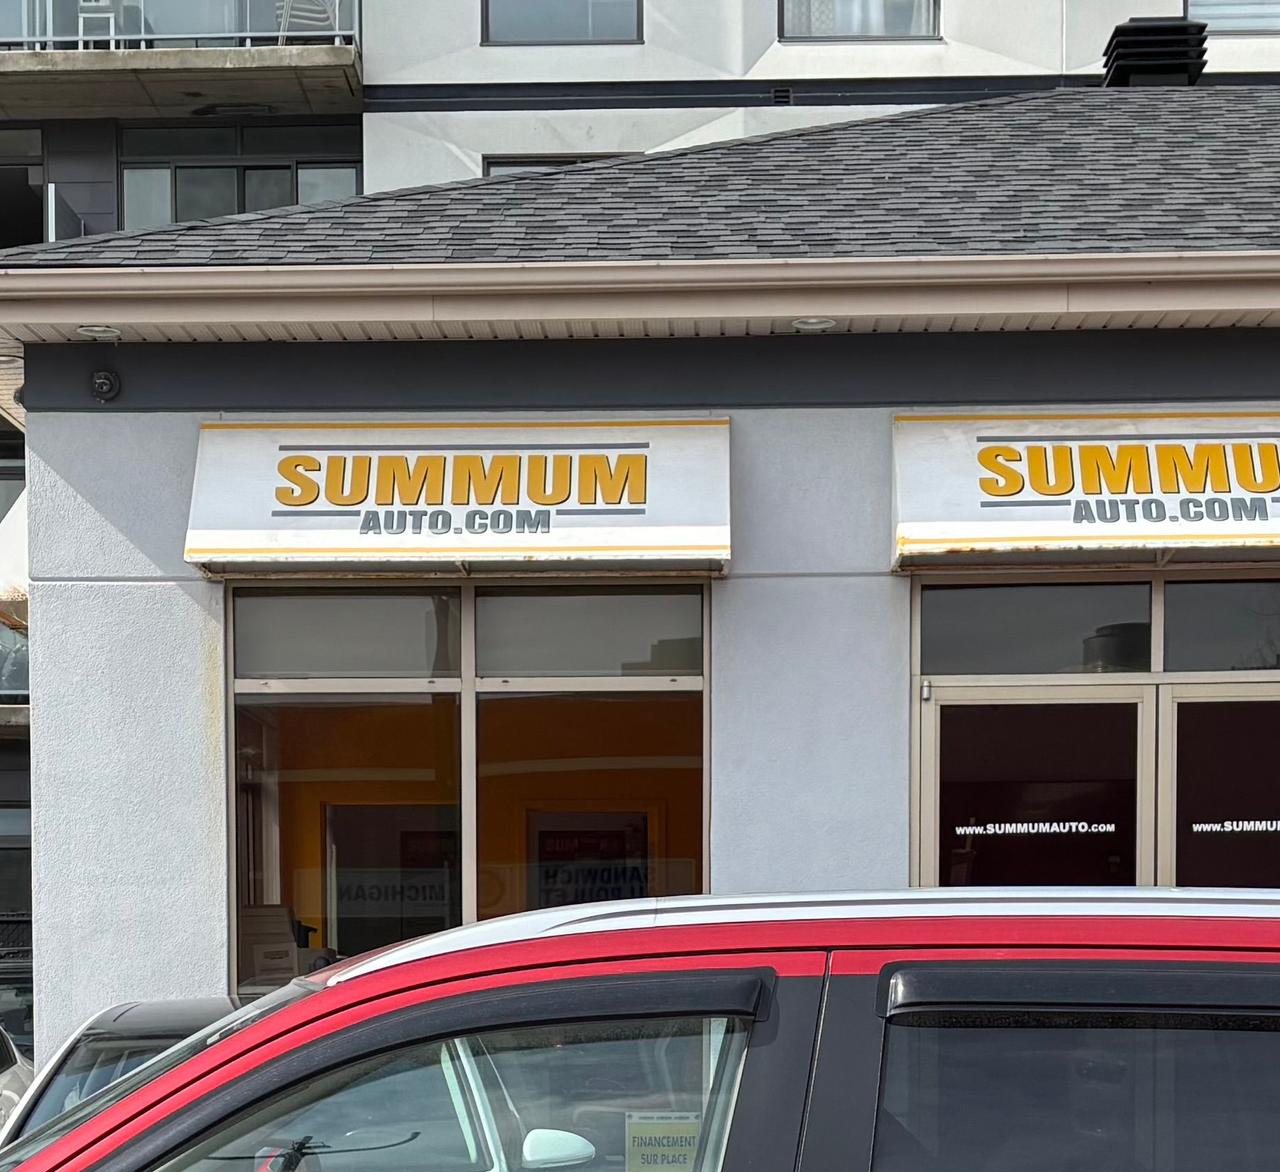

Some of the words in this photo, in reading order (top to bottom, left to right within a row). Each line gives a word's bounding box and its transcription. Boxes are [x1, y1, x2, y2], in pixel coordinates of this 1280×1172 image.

[274, 453, 648, 507] SUMMUM
[359, 508, 551, 535] AUTO.COM
[1072, 496, 1270, 524] AUTO.COM
[632, 1136, 697, 1148] FINANCEMENT
[640, 1153, 659, 1165] SUR
[661, 1153, 688, 1165] PLACE
